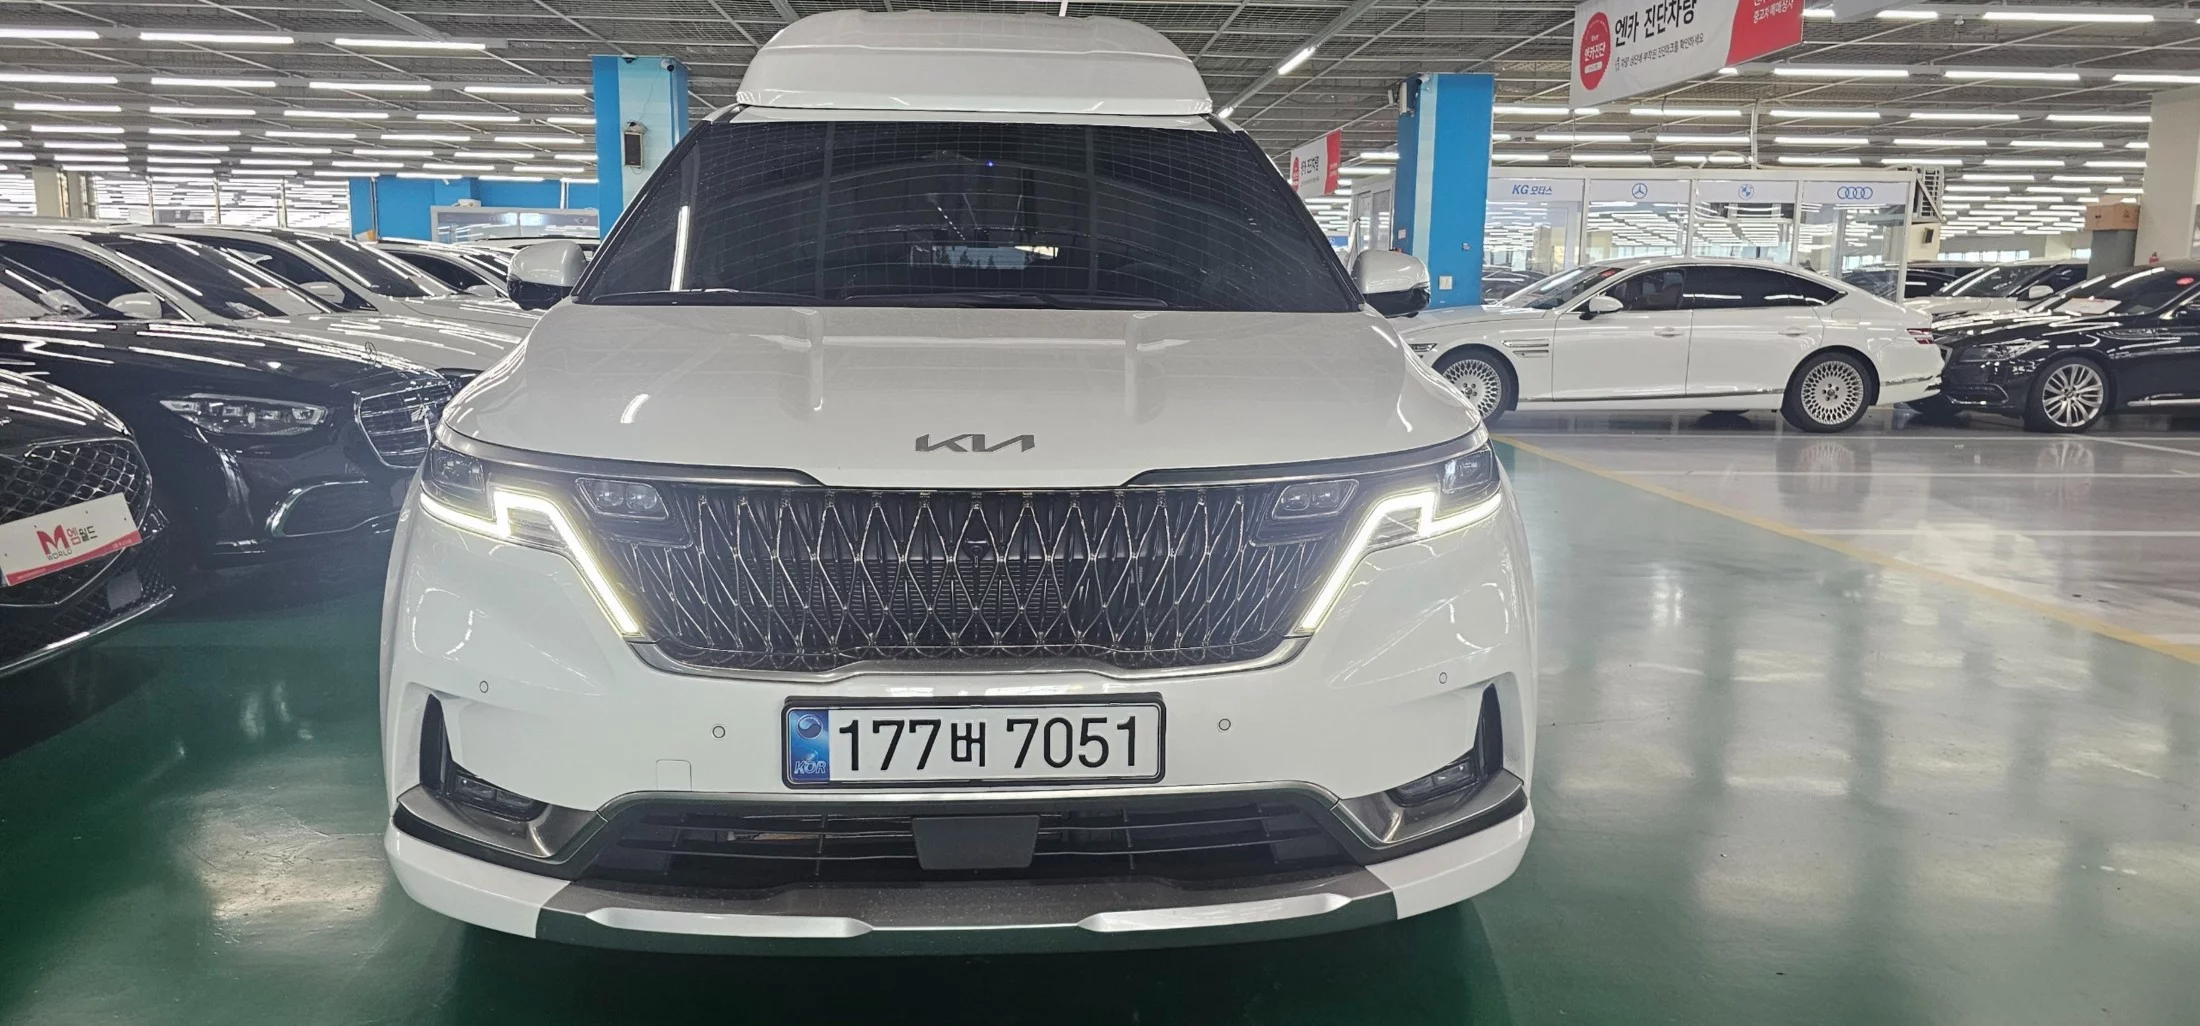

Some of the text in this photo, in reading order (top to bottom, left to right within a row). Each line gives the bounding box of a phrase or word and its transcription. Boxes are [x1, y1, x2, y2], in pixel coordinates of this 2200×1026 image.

[1615, 11, 1639, 47] 엔카
[1512, 184, 1552, 195] KG 모터스
[915, 433, 1035, 452] KIA
[47, 548, 73, 560] WORLD
[839, 716, 1136, 771] 177버 7051
[794, 761, 827, 774] KOR
